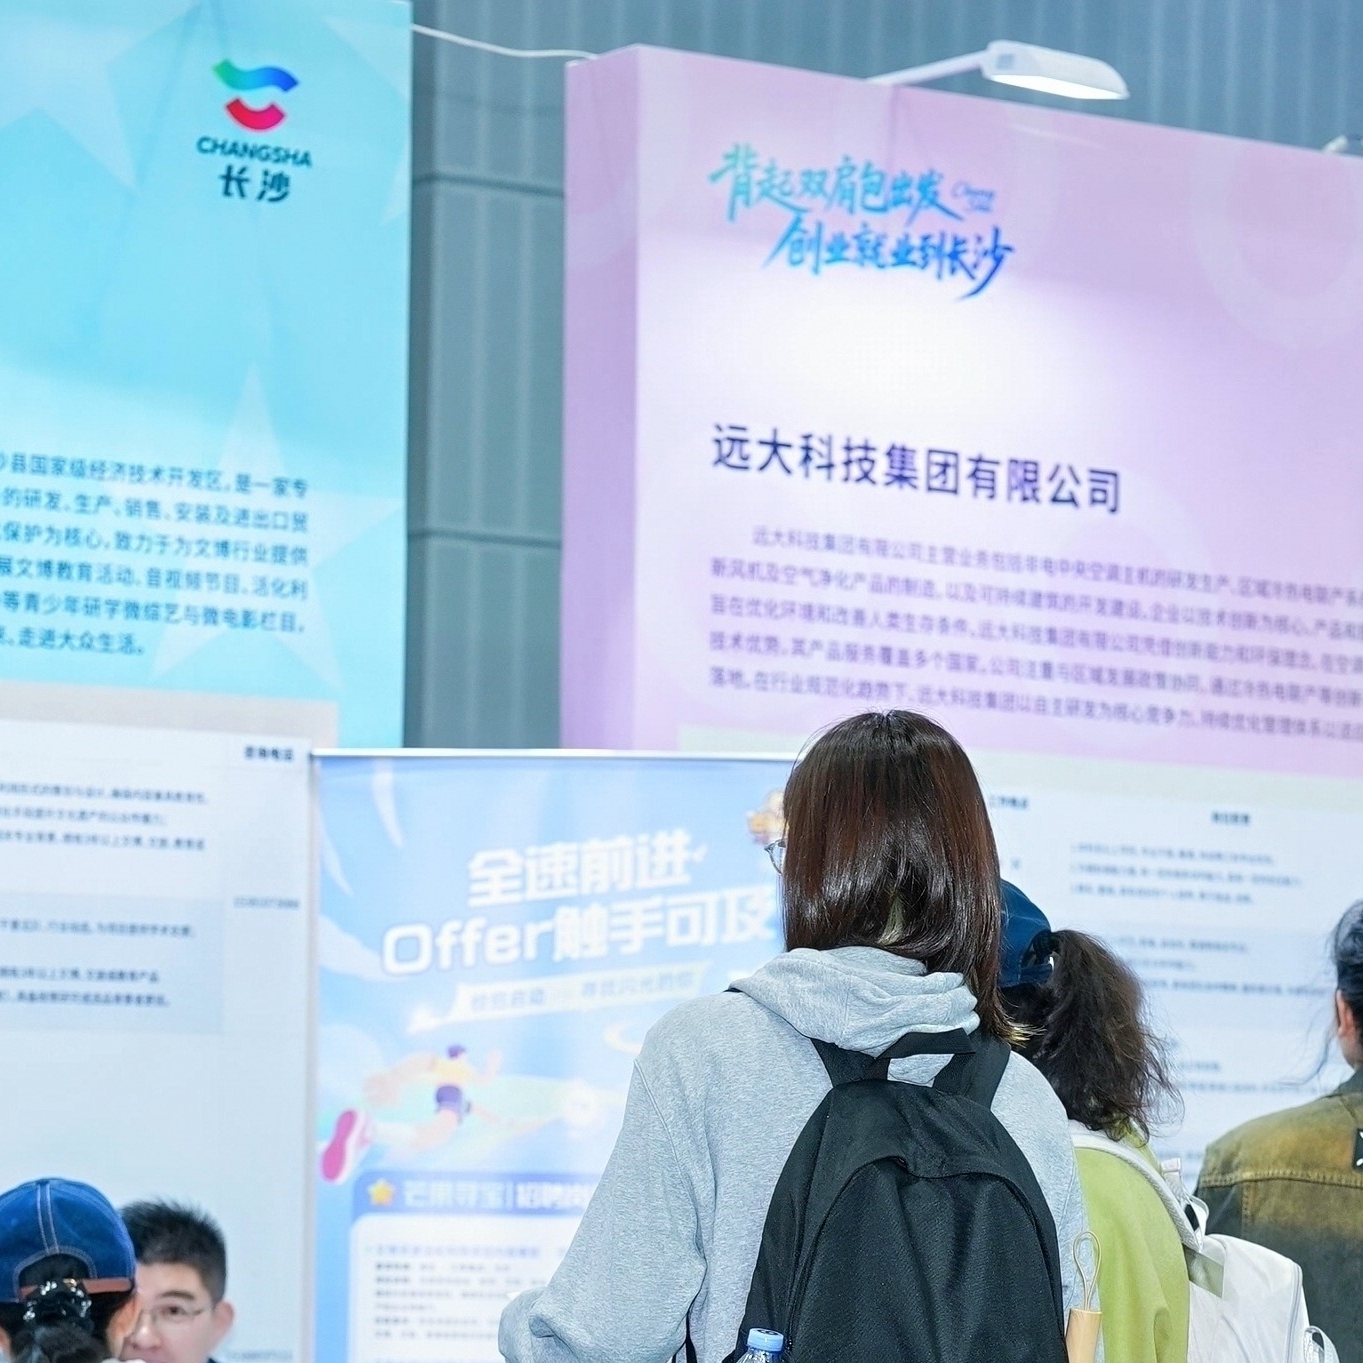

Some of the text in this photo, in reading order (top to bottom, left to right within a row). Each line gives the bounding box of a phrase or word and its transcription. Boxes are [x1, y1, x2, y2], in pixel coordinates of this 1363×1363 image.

[196, 136, 312, 168] CHANGSHA
[219, 164, 290, 203] 长沙
[712, 423, 1121, 514] 远大科技集团有限公司
[467, 828, 693, 908] 全速前进
